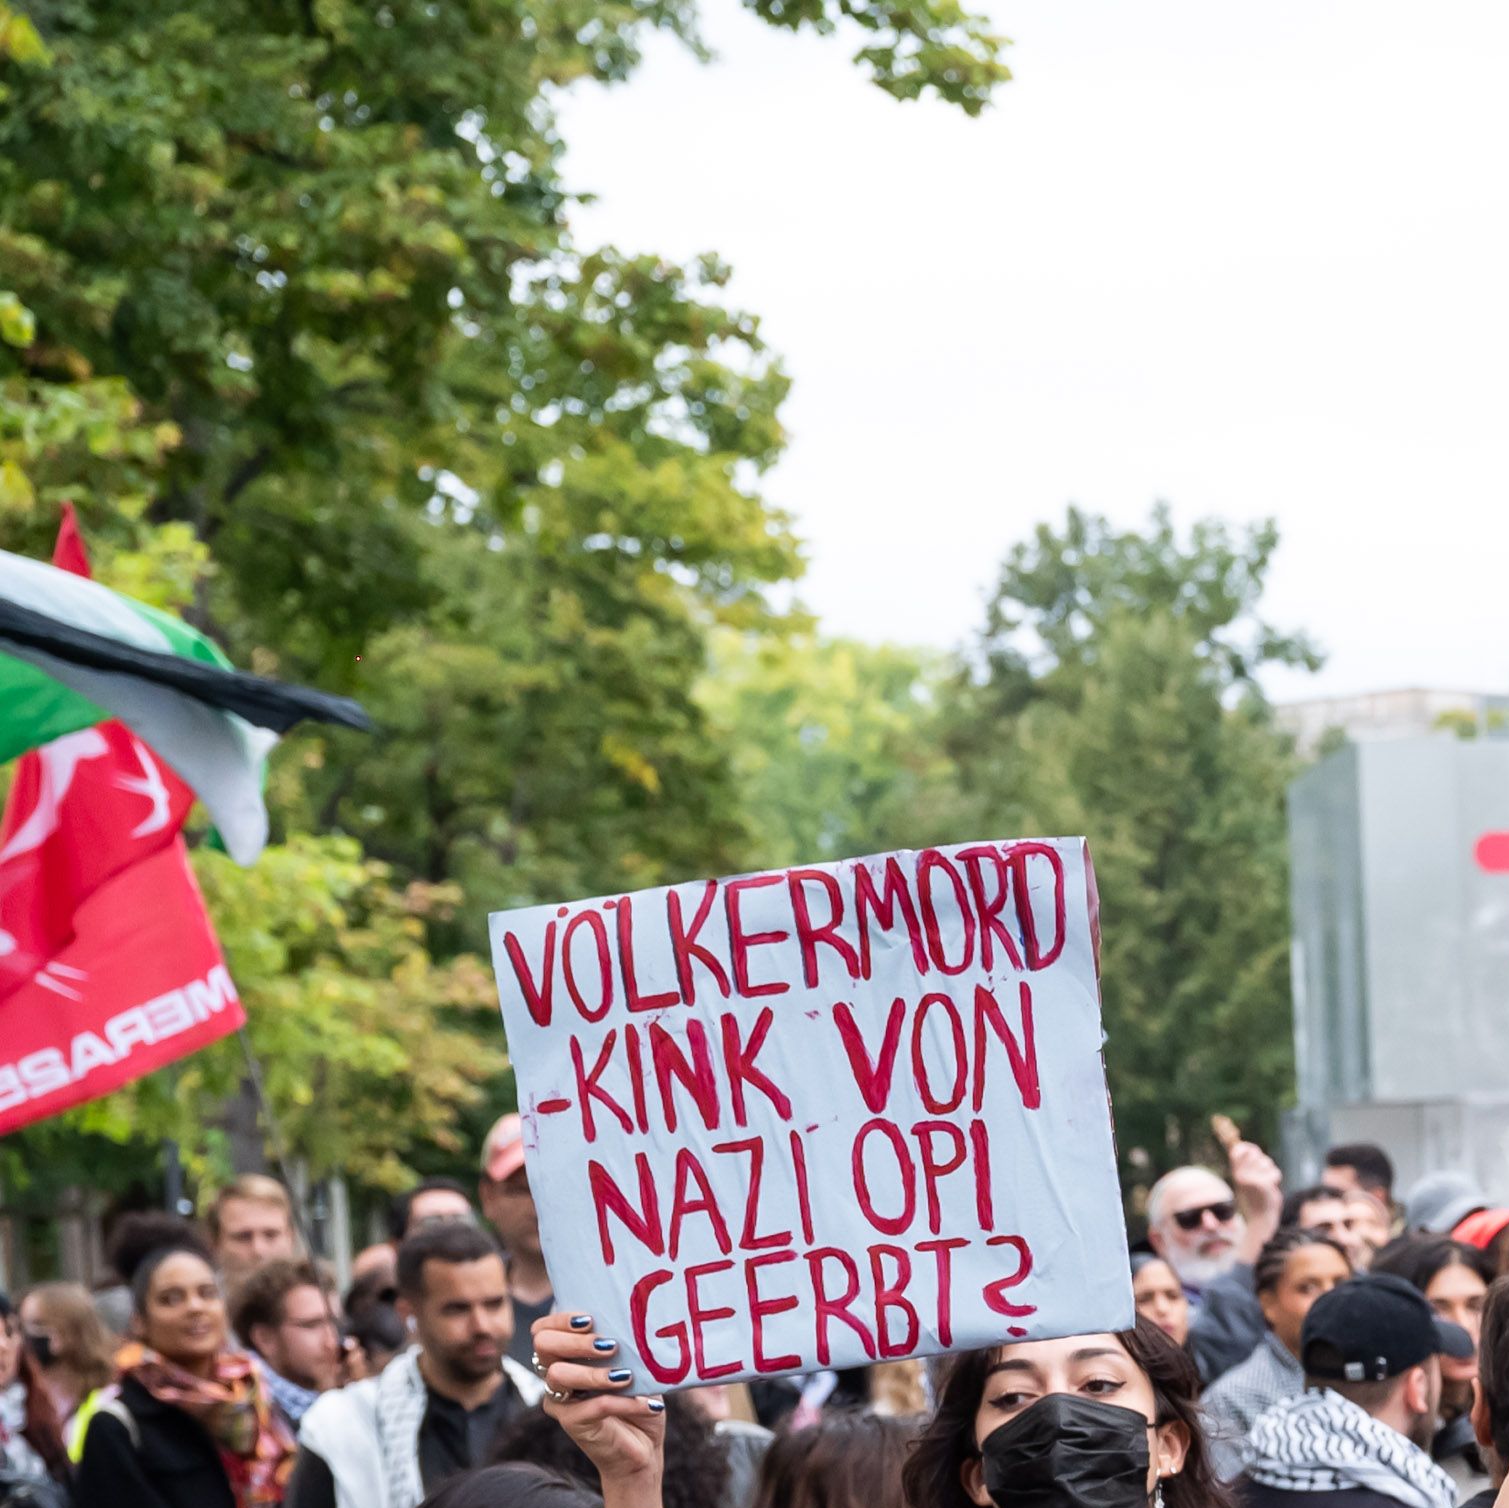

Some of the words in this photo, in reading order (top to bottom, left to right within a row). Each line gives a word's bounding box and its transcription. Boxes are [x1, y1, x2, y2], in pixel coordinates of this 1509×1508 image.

[503, 841, 1067, 1028] VÖLKERMORD
[536, 1006, 793, 1144] -KINK
[832, 981, 1041, 1116] VON
[587, 1129, 815, 1266] NAZI
[852, 1117, 995, 1236] OPI
[629, 1234, 1038, 1385] GEERBT?
